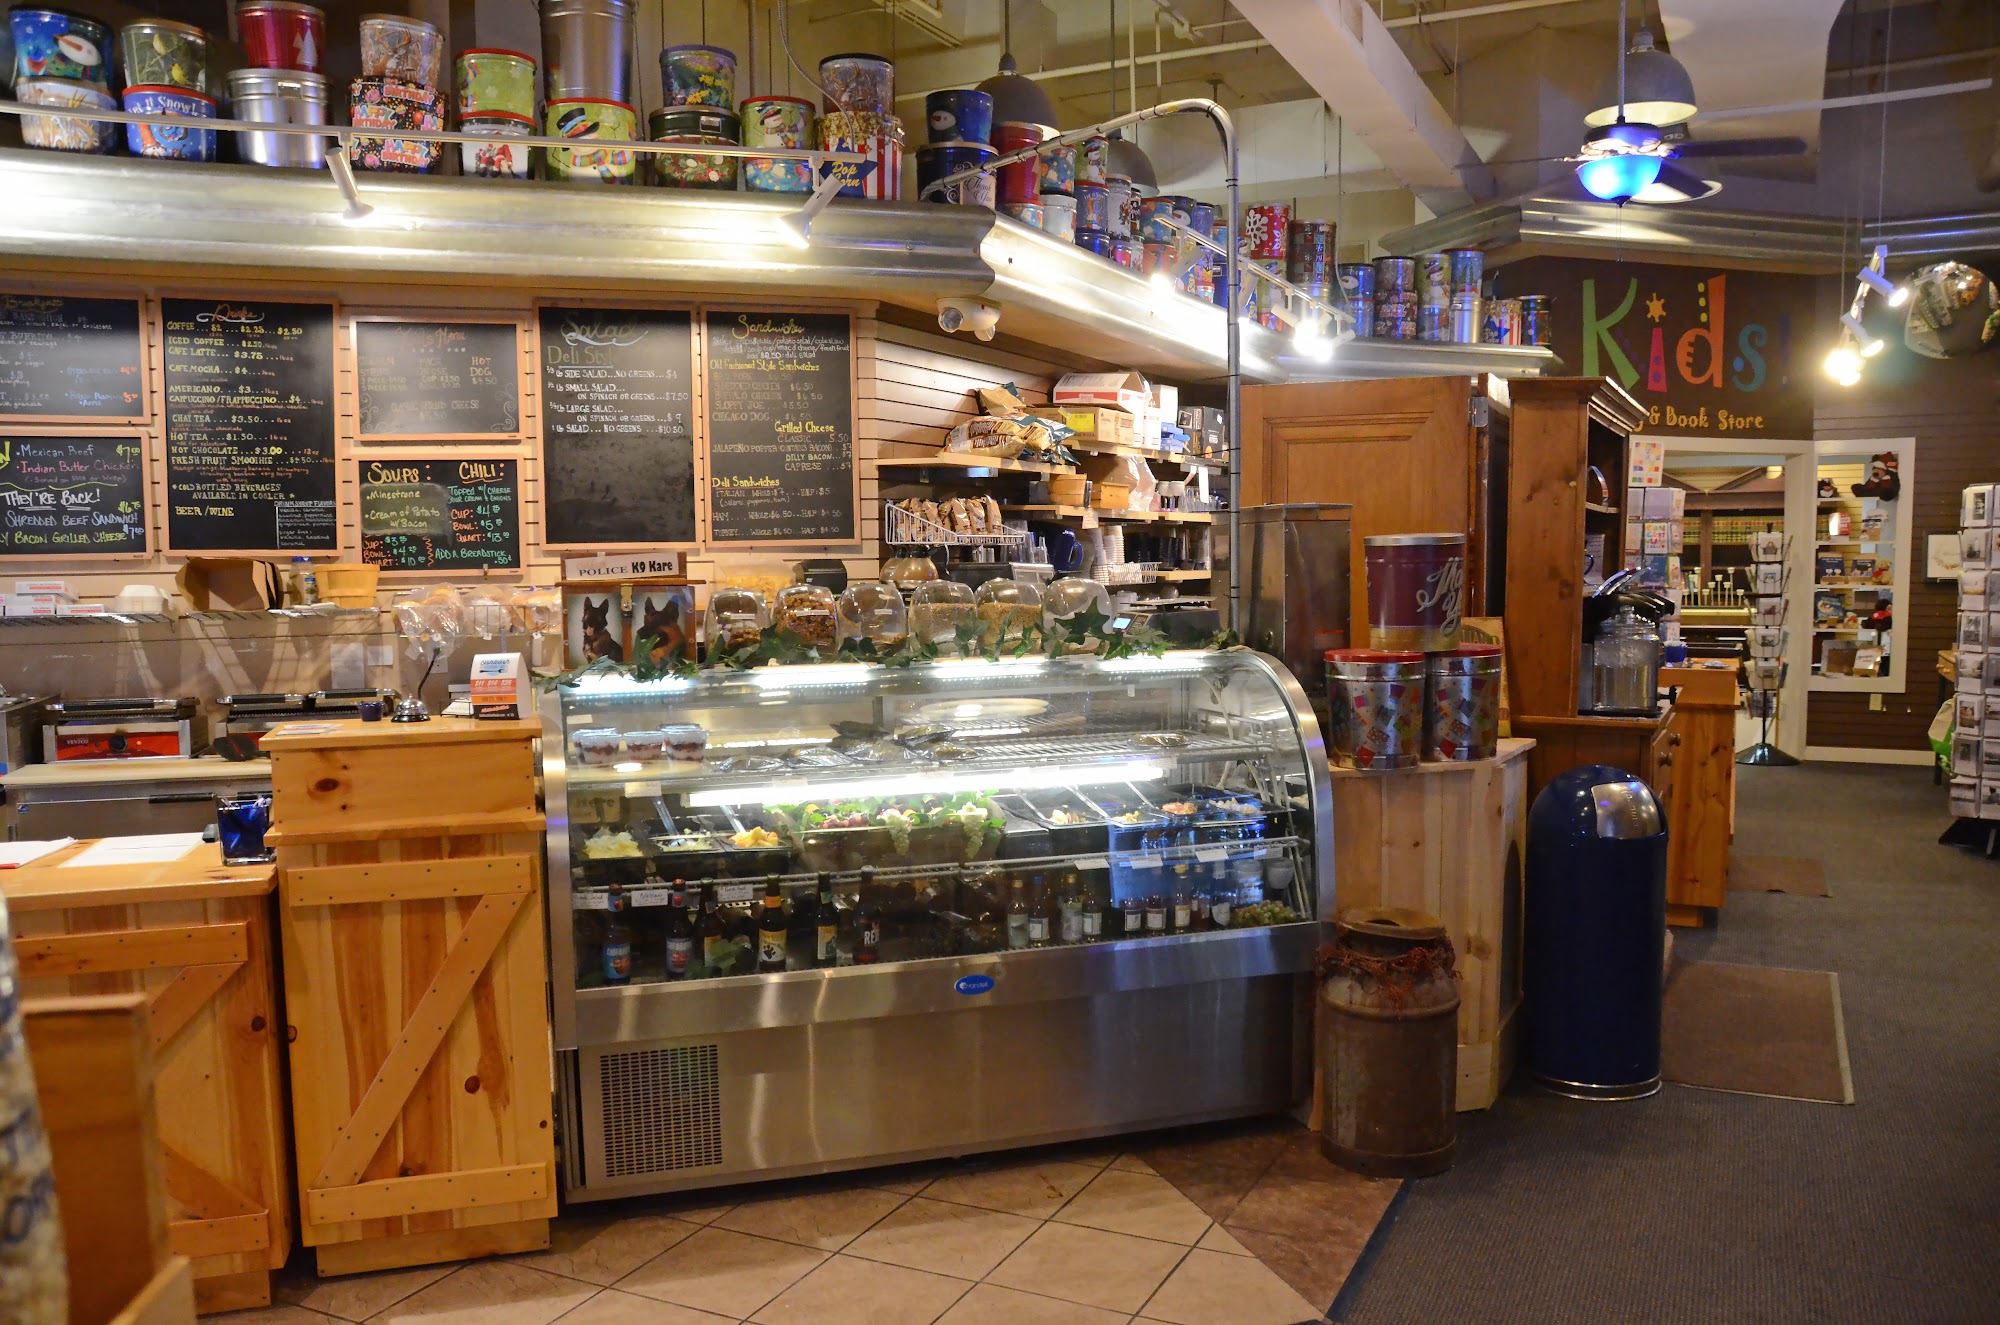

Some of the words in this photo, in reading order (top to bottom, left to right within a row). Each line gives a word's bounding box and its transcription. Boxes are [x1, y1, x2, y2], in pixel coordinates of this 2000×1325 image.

[832, 161, 858, 178] Pop
[168, 336, 190, 345] ICED
[194, 337, 225, 346] COFFEE
[190, 348, 217, 357] LATTE
[547, 345, 580, 364] Deli
[472, 357, 491, 365] HOT
[780, 360, 820, 371] Sandwiches
[190, 365, 220, 374] MOCHA
[470, 367, 492, 376] DOG
[564, 369, 580, 378] SIDE
[582, 369, 607, 378] SALAD
[615, 370, 627, 378] NO
[628, 369, 655, 378] GREENS
[169, 385, 221, 394] AMERICANO
[565, 383, 590, 392] SMALL
[591, 383, 617, 392] SALAD
[589, 392, 615, 400] SPINACH
[566, 404, 590, 412] LARGE
[592, 404, 615, 412] SALAD
[172, 415, 192, 424] CHAI
[194, 415, 211, 423] TEA
[712, 412, 748, 421] CHICAGO
[750, 412, 770, 420] DOG
[1666, 406, 1709, 427] Book
[1718, 410, 1765, 430] Store
[566, 424, 590, 433] SALAD
[603, 424, 615, 432] NO
[616, 424, 642, 433] GREENS
[774, 421, 802, 432] Grilled
[805, 421, 835, 432] Cheese
[170, 433, 189, 441] HOT
[777, 434, 811, 443] CLASSIC
[20, 444, 65, 457] Mexican
[68, 444, 94, 457] Beef
[171, 446, 189, 454] HOT
[192, 446, 239, 455] CHOCOLATE
[171, 456, 200, 465] FRESH
[201, 457, 227, 465] FRUIT
[20, 461, 56, 473] Indian
[59, 461, 90, 472] Butter
[94, 459, 140, 471] Chicken
[785, 462, 822, 471] CAPRESE
[712, 477, 730, 488] Deli
[732, 475, 780, 487] Sandwiches
[61, 488, 100, 506] BACK!
[192, 492, 236, 500] AVAILABLE
[370, 490, 421, 500] Minestrone
[175, 506, 202, 516] BEER
[370, 510, 397, 520] Cream
[400, 506, 409, 518] of
[411, 506, 441, 518] Potato
[5, 510, 57, 527] SHREDDED
[62, 515, 89, 526] BEEF
[92, 511, 138, 526] SANDWICH
[401, 518, 428, 528] Bacon
[14, 530, 48, 544] BACON
[52, 532, 91, 544] GRILLED
[93, 532, 127, 543] CHEESE
[435, 548, 450, 559] ADD
[460, 548, 507, 558] BREADSTICK
[579, 566, 628, 577] POLICE
[631, 561, 646, 574] K9
[649, 560, 673, 572] Kare
